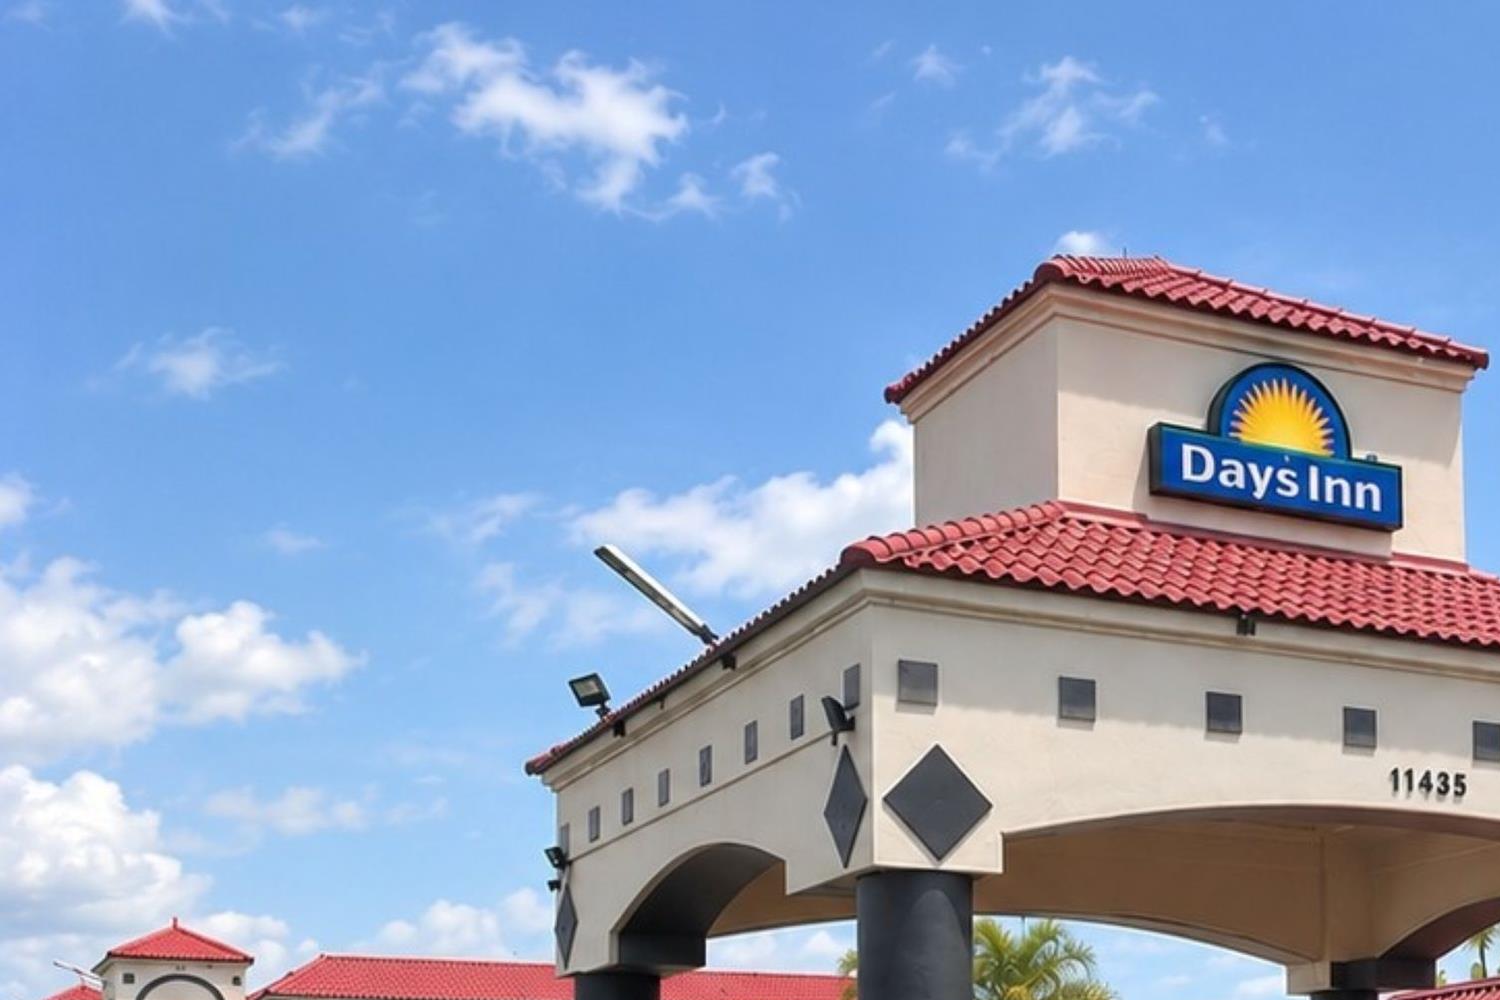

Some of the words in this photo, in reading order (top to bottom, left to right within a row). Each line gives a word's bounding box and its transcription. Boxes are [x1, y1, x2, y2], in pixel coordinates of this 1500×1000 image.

[1182, 443, 1299, 500] Days
[1309, 465, 1382, 512] Inn
[1391, 767, 1467, 797] 11435
